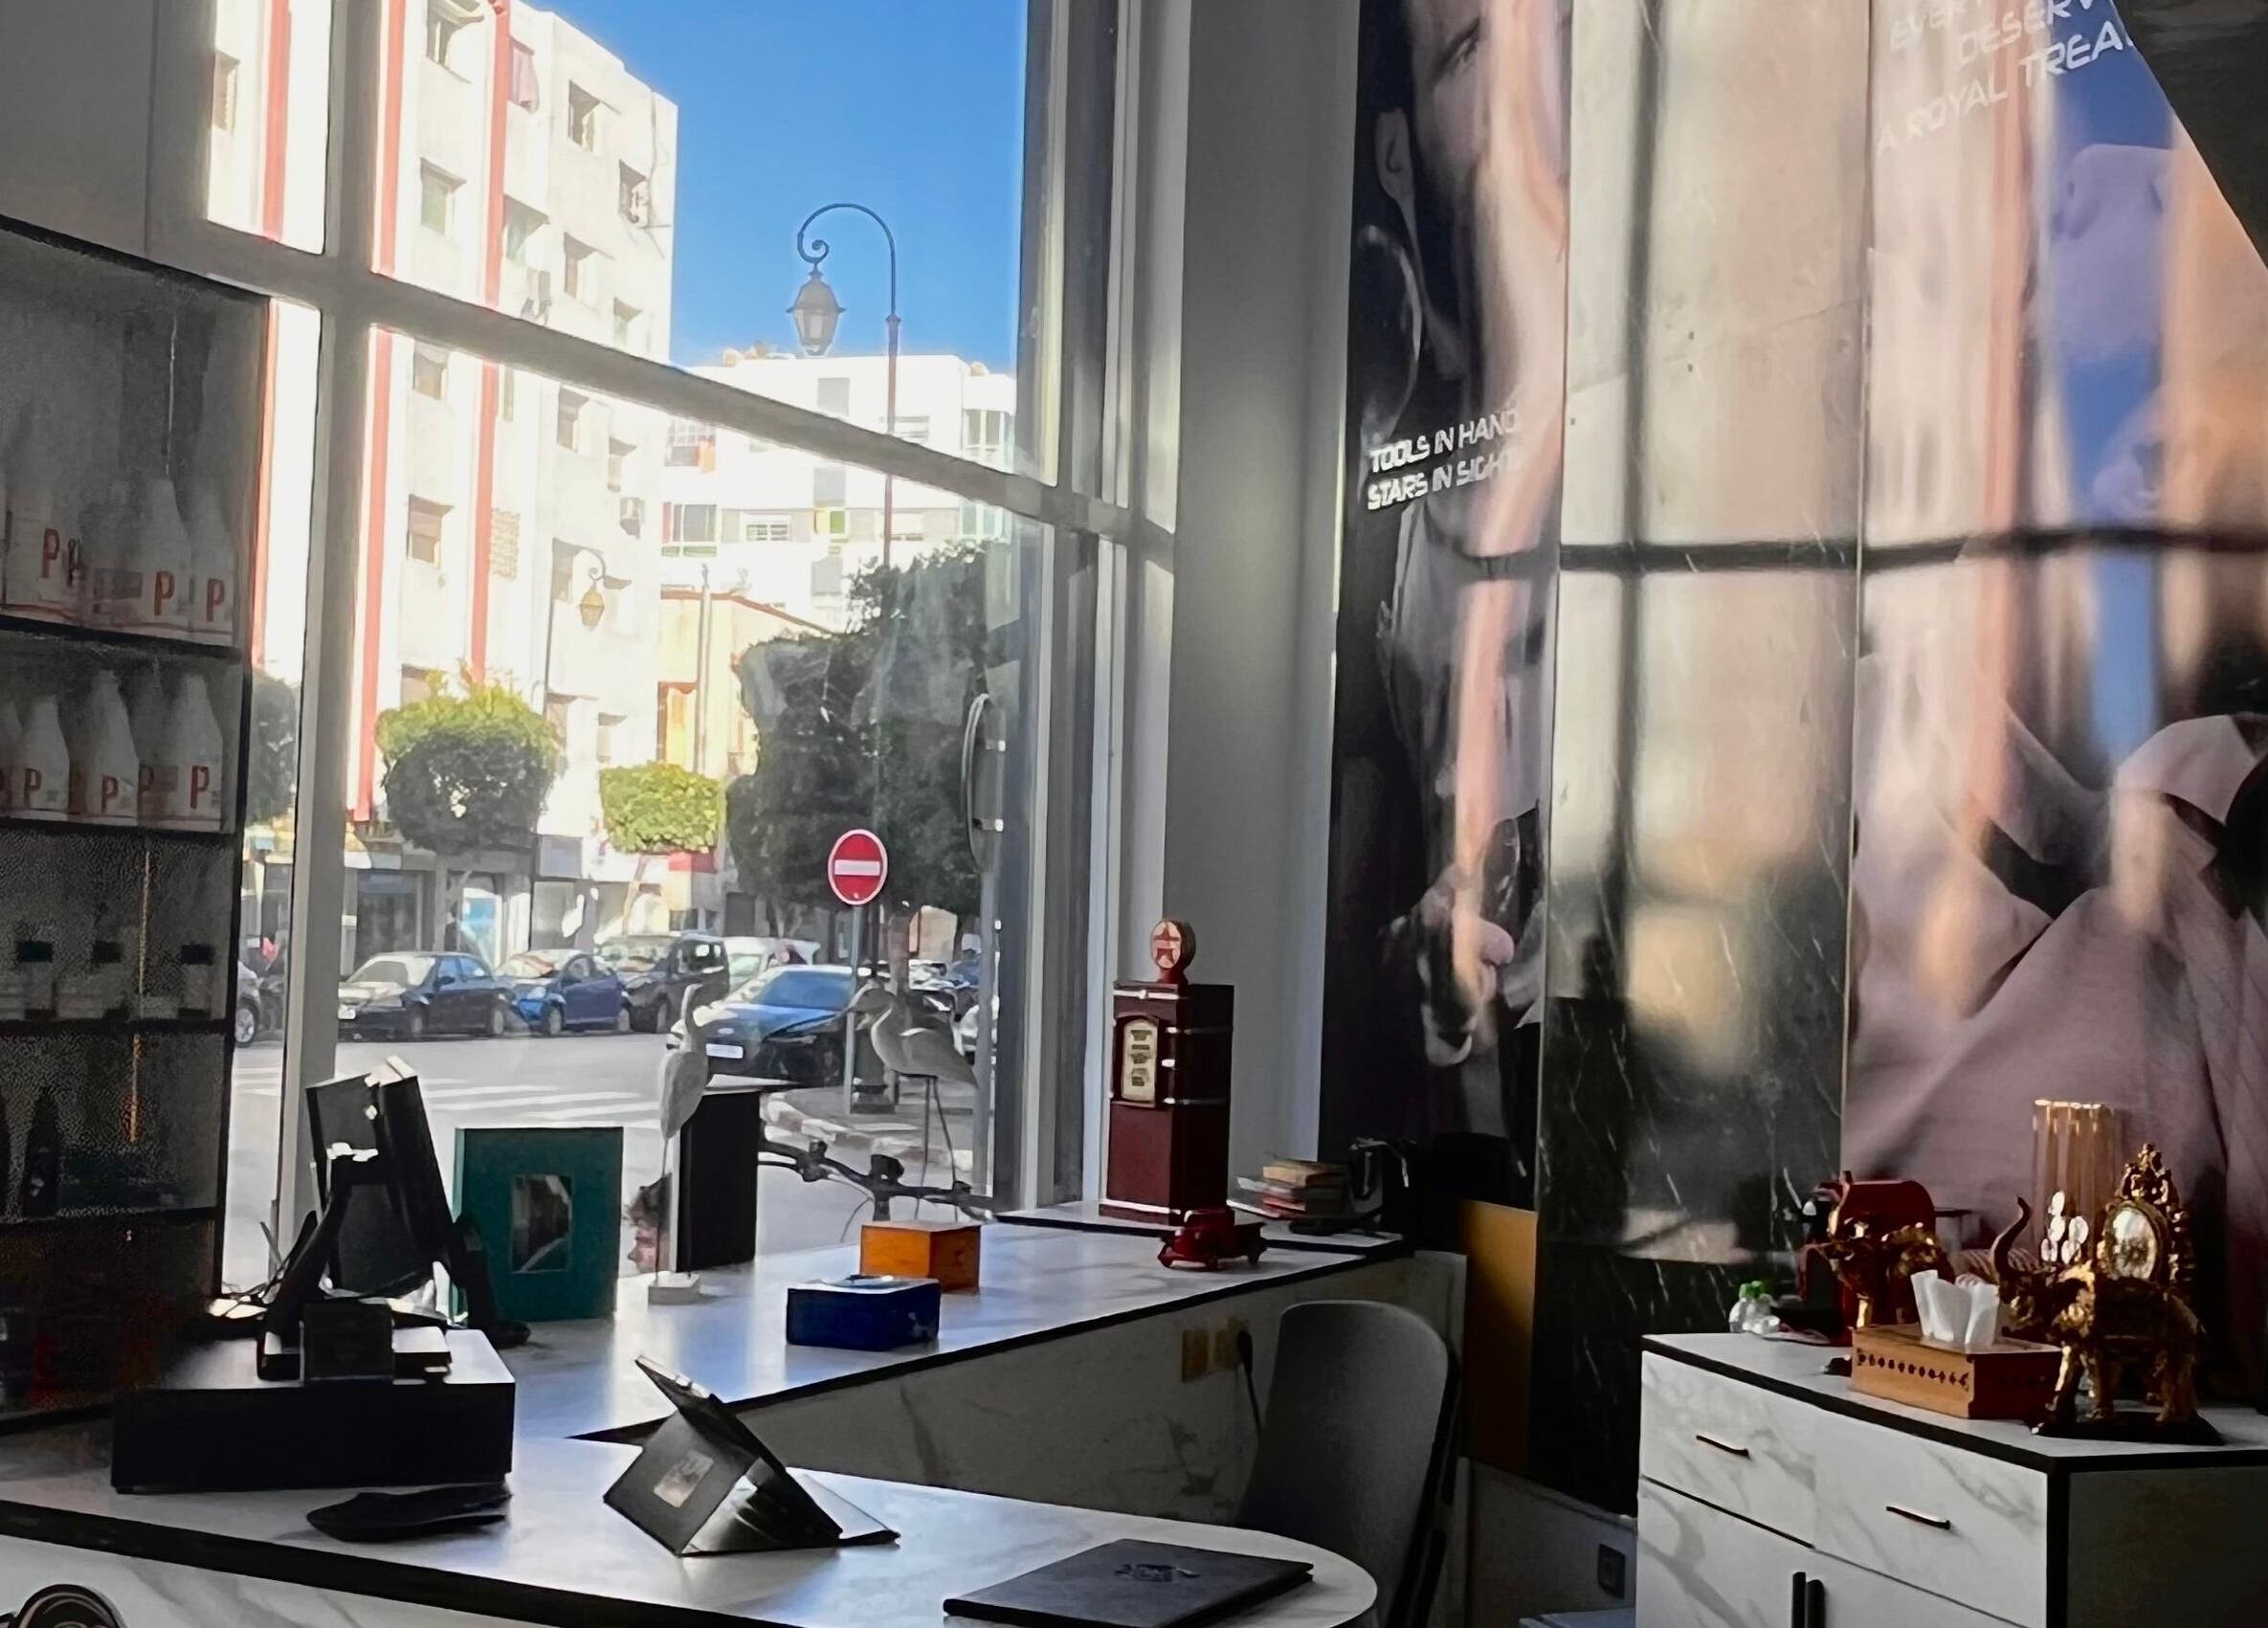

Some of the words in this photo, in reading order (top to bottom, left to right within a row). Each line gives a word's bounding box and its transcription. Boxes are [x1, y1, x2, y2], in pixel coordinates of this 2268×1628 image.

[1905, 67, 2008, 144] ROYAL
[2018, 21, 2134, 87] TREA
[1368, 435, 1430, 474] TOOLS
[1434, 426, 1455, 455] IN
[1457, 409, 1518, 449] HAND
[1367, 472, 1429, 511] STARS
[1433, 464, 1453, 493] IN
[41, 527, 60, 579] P
[154, 570, 175, 616] P
[206, 577, 225, 621] P
[23, 767, 42, 810] P
[101, 773, 119, 813] P
[190, 765, 210, 810] P
